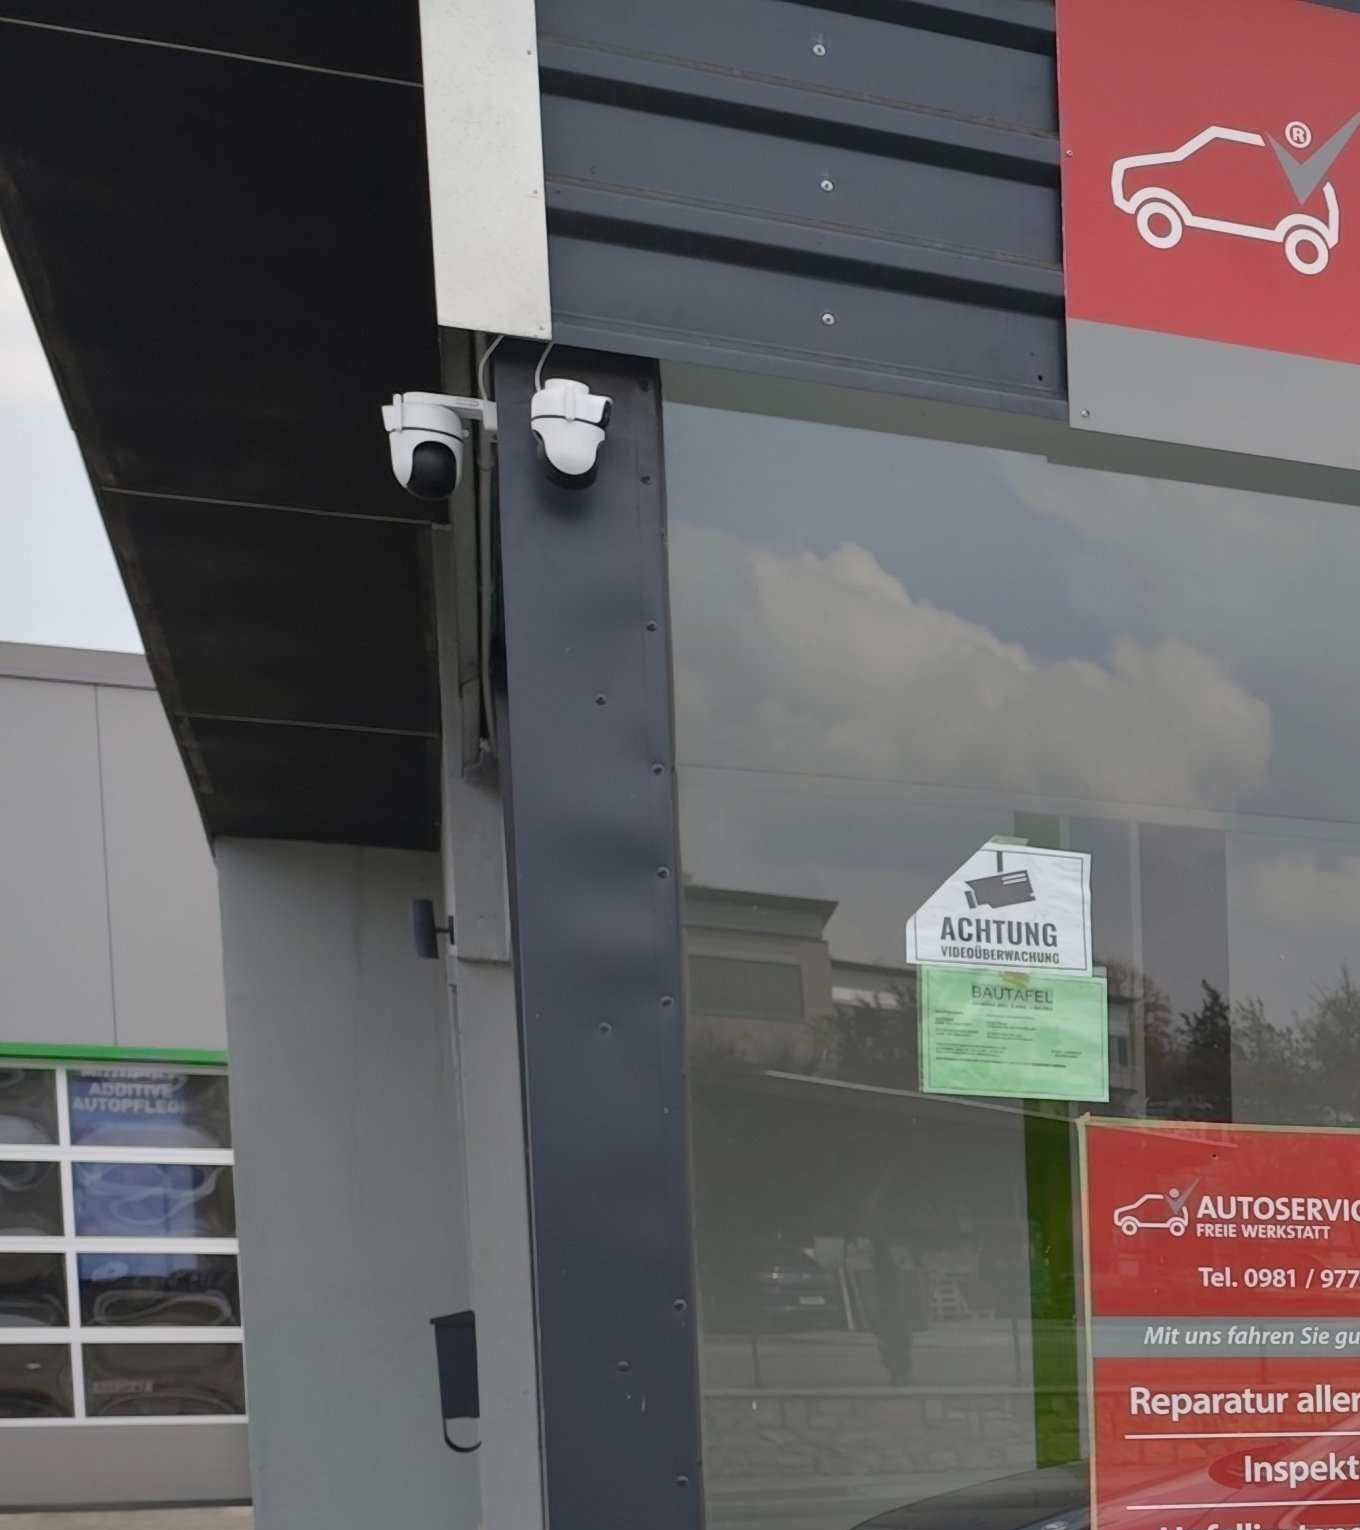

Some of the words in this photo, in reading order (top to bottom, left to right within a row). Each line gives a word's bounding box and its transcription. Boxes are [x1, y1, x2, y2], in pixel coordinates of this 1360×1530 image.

[940, 916, 1058, 947] ACHTUNG
[941, 945, 1060, 964] VIDEOÜBERWACHUNG
[971, 984, 1054, 1004] BAUTAFEL
[1196, 1224, 1238, 1238] FREIE
[1241, 1225, 1331, 1240] WERKSTATT
[1198, 1266, 1239, 1288] Tel.
[1244, 1268, 1296, 1289] 0981
[1305, 1268, 1315, 1290] /
[1144, 1326, 1180, 1345] Mit
[1185, 1331, 1223, 1346] uns
[1227, 1326, 1295, 1346] fahren
[1300, 1327, 1330, 1346] Sie
[1130, 1386, 1288, 1422] Reparatur
